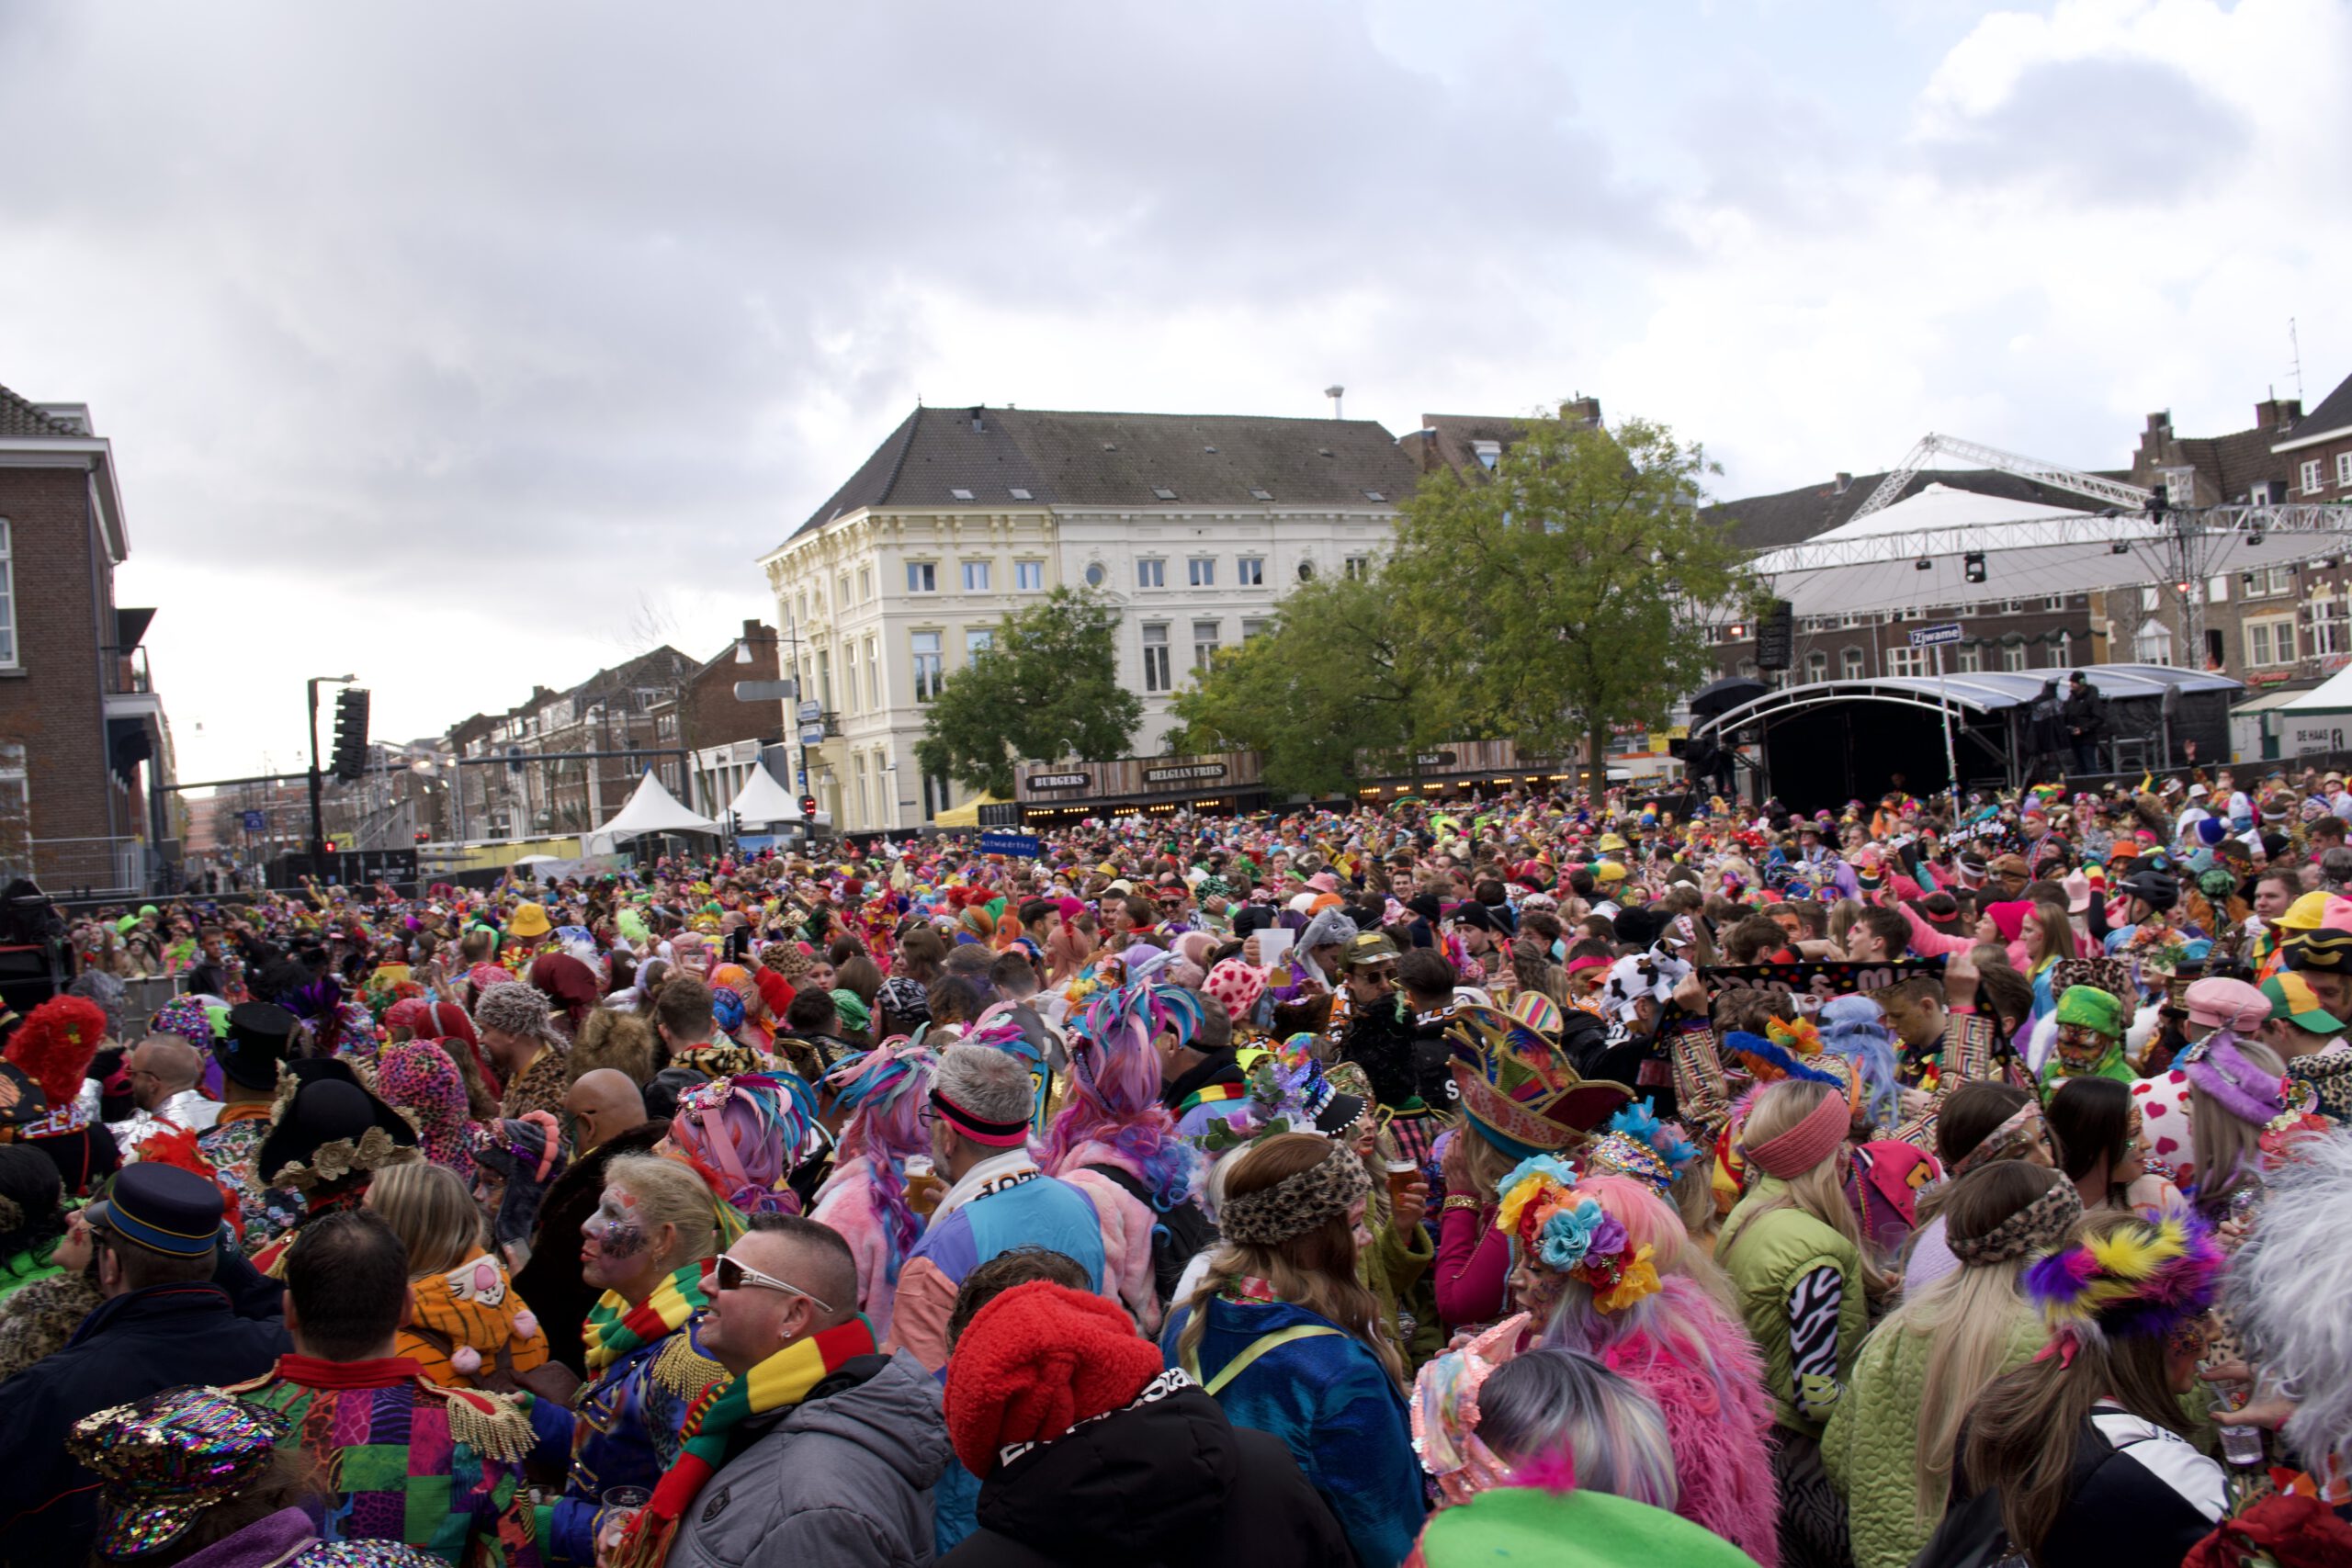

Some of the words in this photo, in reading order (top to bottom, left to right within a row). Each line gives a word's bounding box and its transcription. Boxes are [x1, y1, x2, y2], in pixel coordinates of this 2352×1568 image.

[1914, 628, 1959, 647] Zjwame
[1034, 774, 1085, 787] BURGERS
[1148, 767, 1193, 781] BELGIAN
[1193, 764, 1223, 777] FRIES
